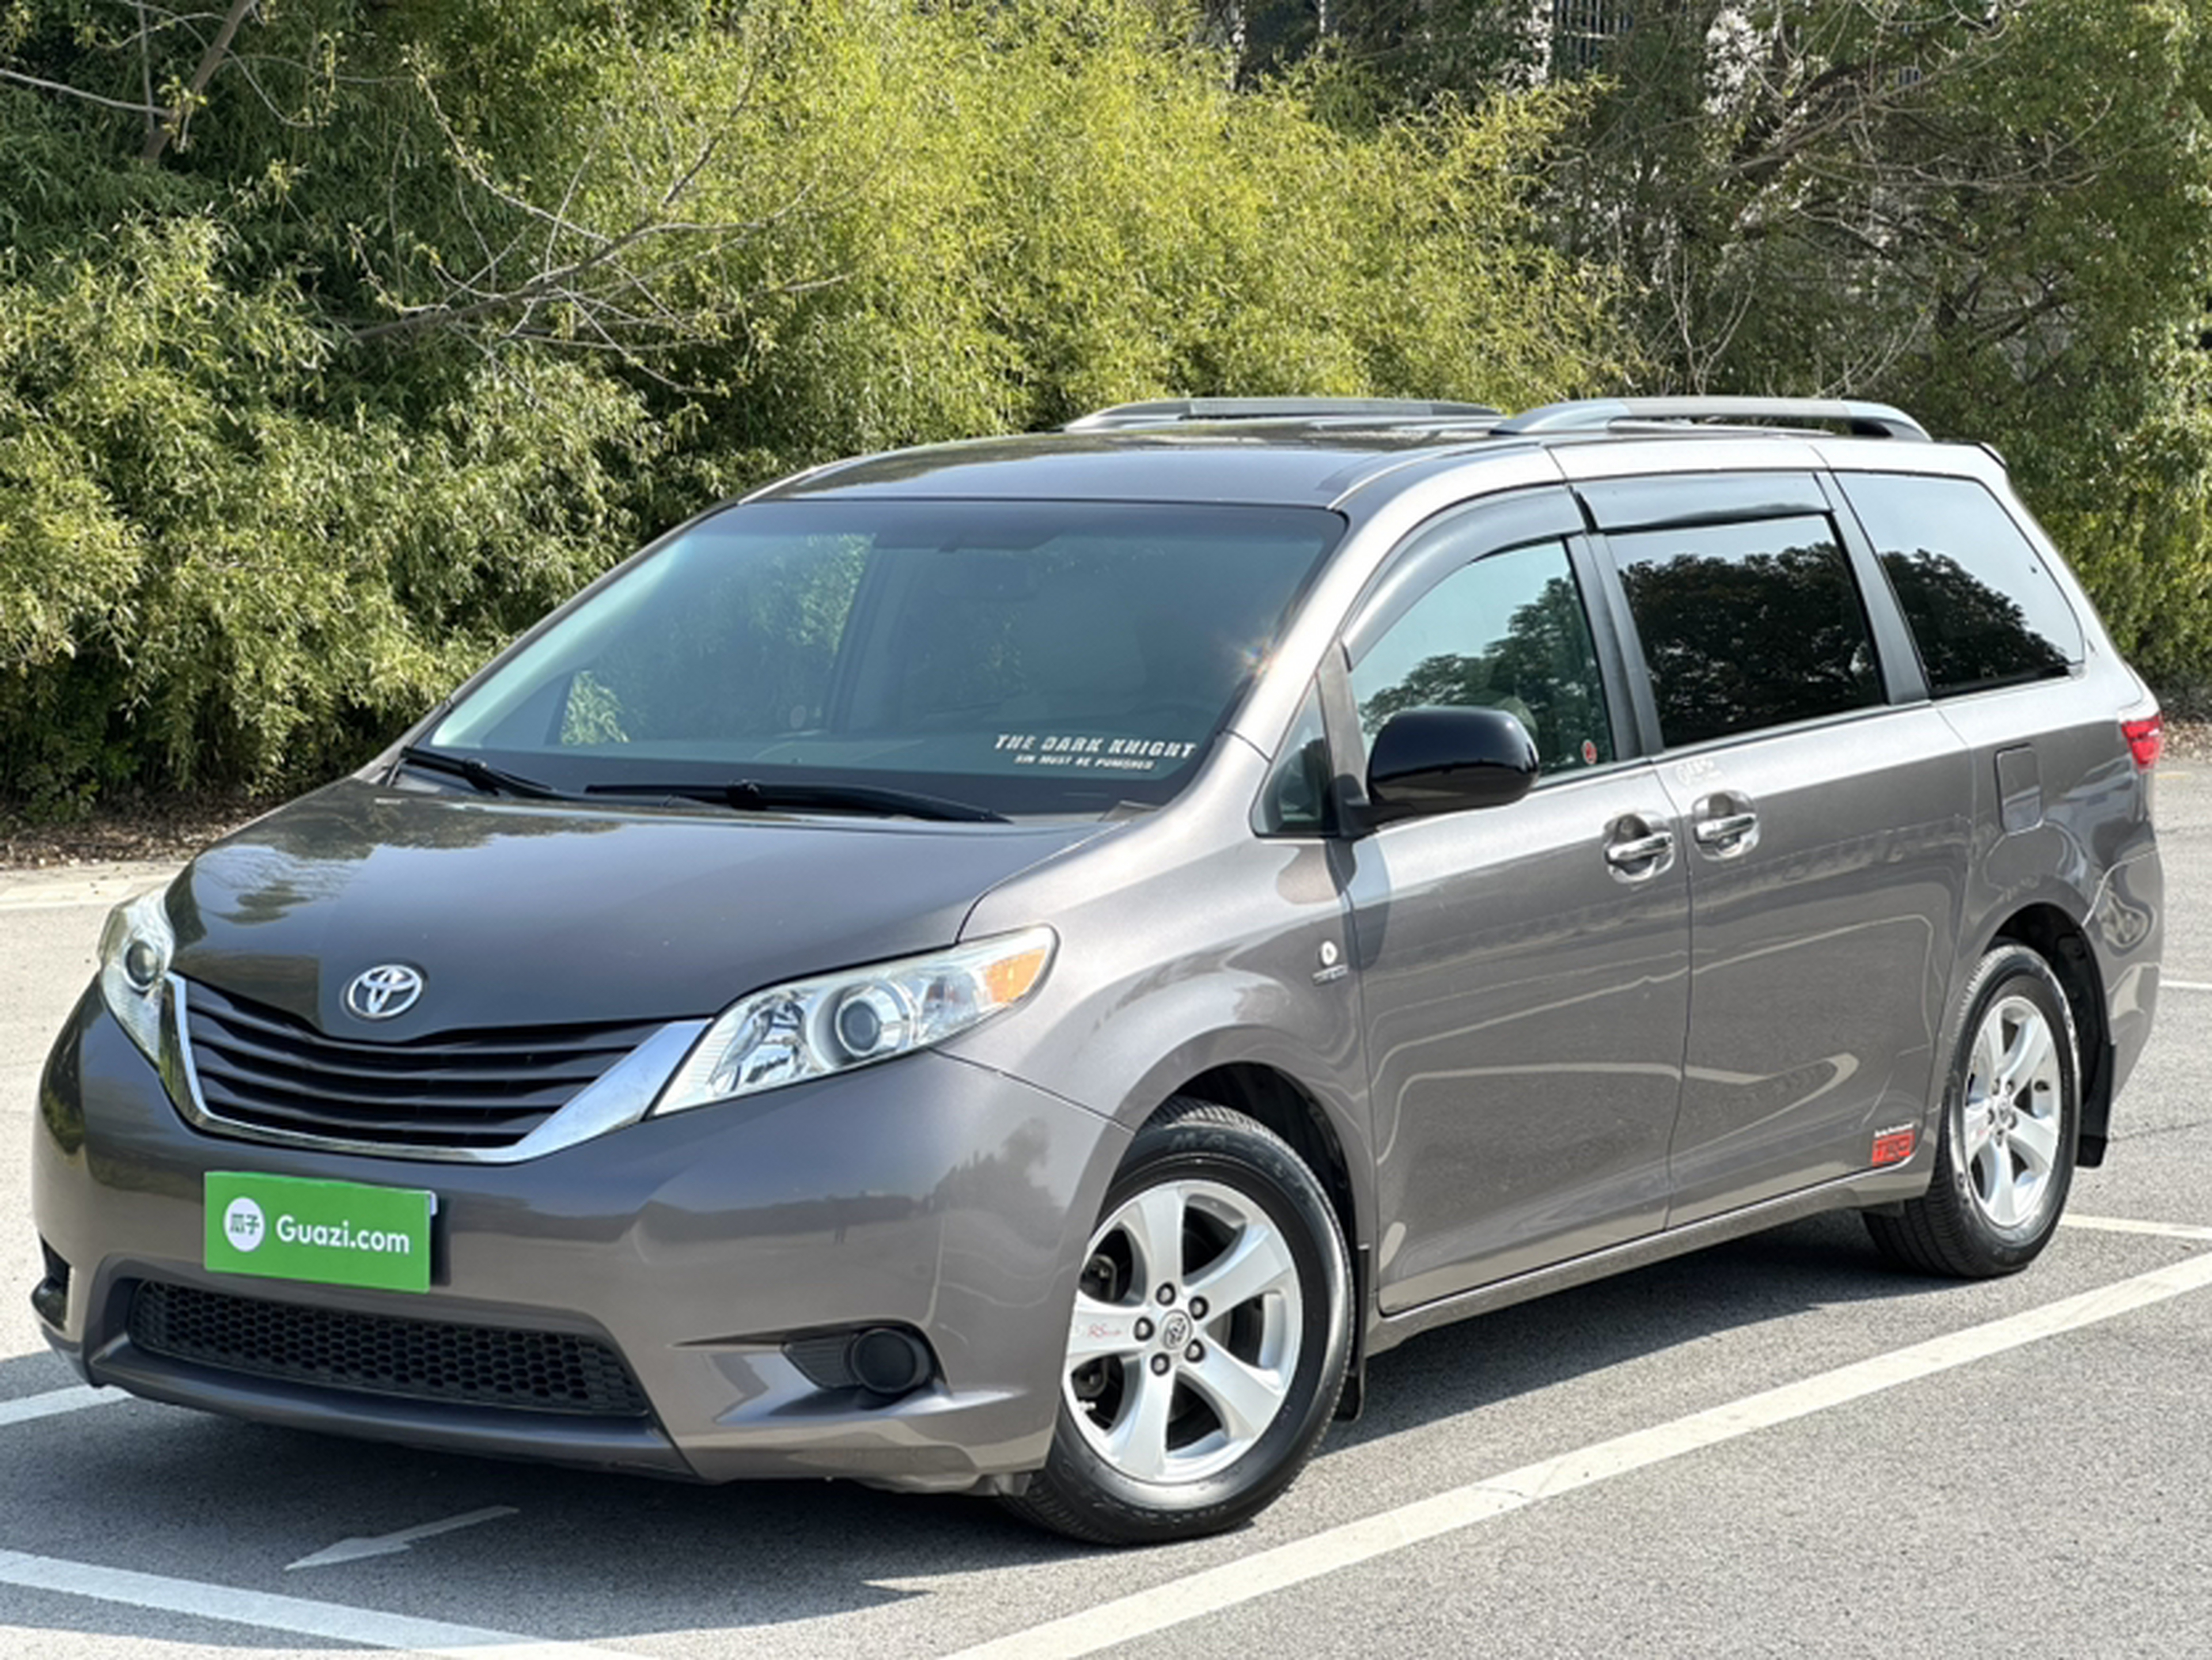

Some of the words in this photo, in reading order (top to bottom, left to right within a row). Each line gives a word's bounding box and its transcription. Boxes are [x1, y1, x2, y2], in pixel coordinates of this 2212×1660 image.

[994, 734, 1036, 750] THE
[1040, 736, 1104, 753] DARK
[1107, 738, 1196, 759] KNIGHT
[1038, 755, 1073, 765] MUST
[276, 1214, 410, 1255] Guazi.com
